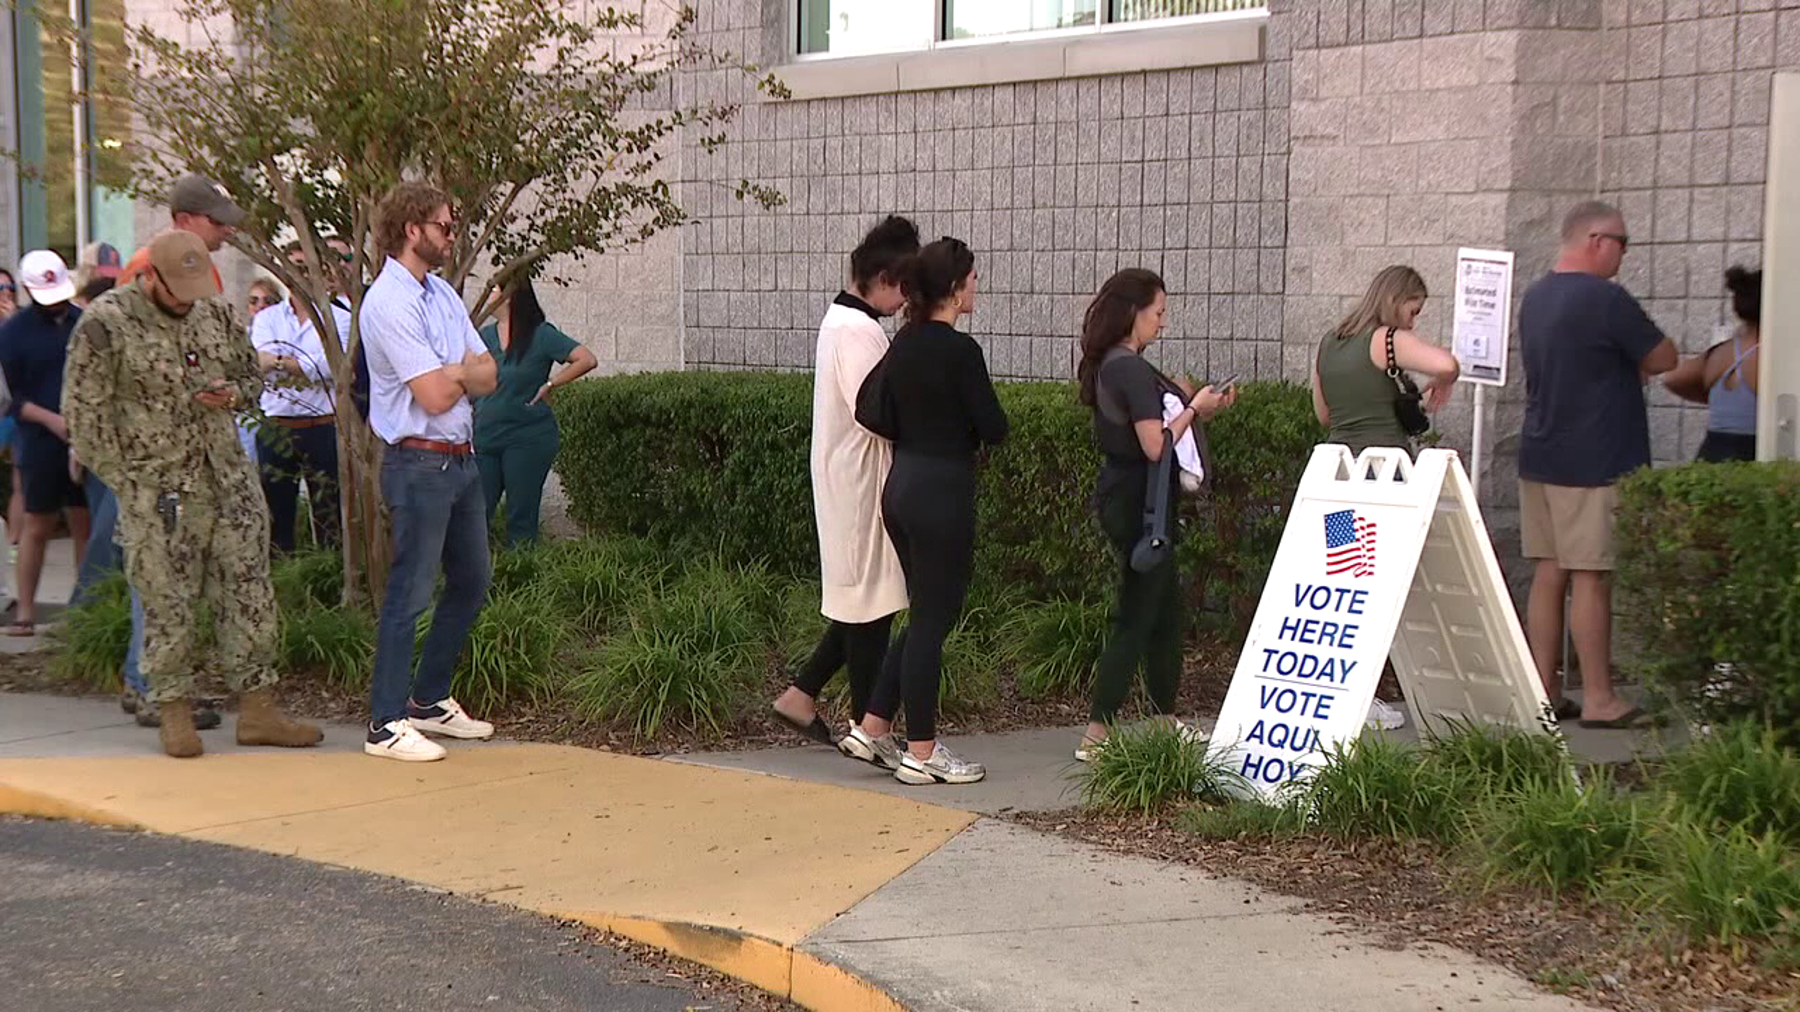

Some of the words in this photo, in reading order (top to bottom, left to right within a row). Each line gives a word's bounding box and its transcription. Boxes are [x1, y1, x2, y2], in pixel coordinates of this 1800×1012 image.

[1295, 583, 1369, 614] VOTE
[1278, 616, 1359, 649] HERE
[1262, 648, 1358, 684] TODAY
[1260, 685, 1335, 720] VOTE
